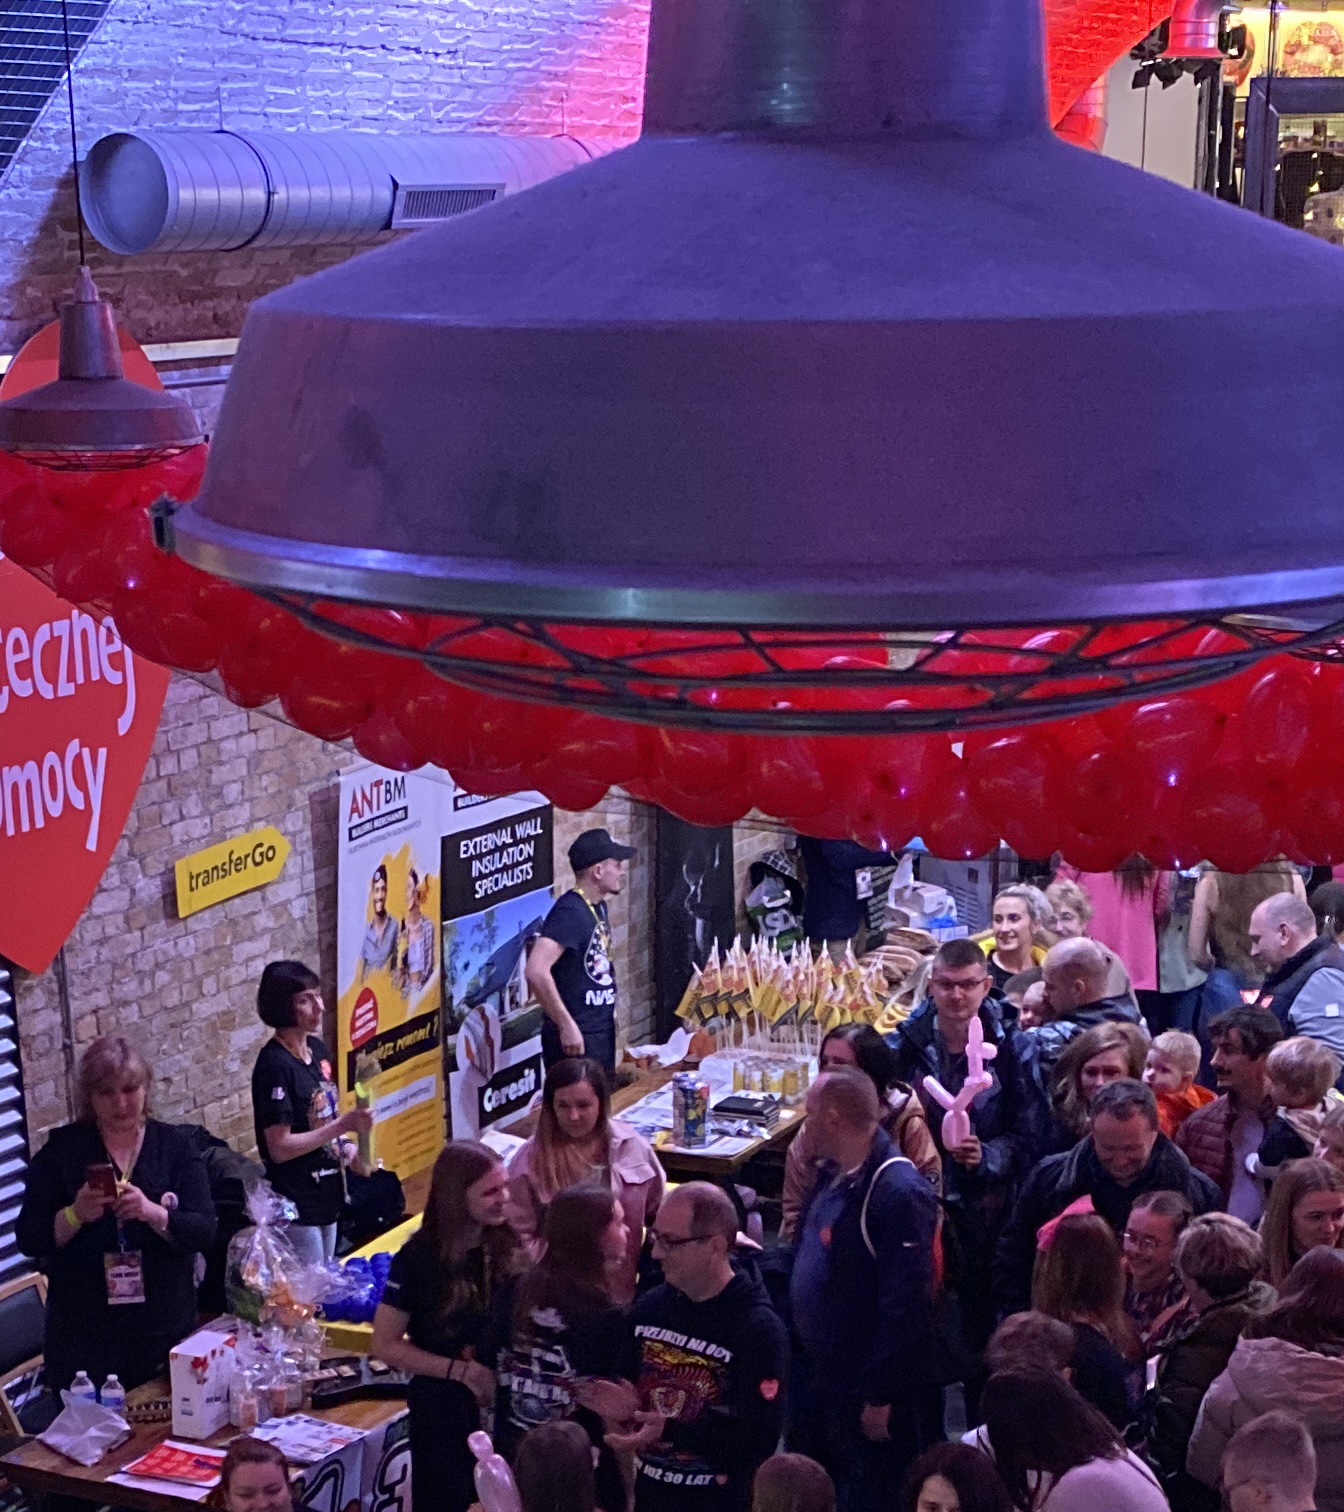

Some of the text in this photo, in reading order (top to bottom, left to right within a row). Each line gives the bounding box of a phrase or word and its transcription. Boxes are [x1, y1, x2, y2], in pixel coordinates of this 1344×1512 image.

[459, 816, 543, 859] EXTERNAL WALL
[189, 842, 276, 892] transferGo
[471, 841, 535, 878] INSULATION
[474, 861, 533, 899] SPECIALISTS
[483, 1068, 536, 1112] Ceresit
[685, 1337, 708, 1353] NA
[663, 1470, 684, 1485] 30
[685, 1473, 714, 1486] LAT
